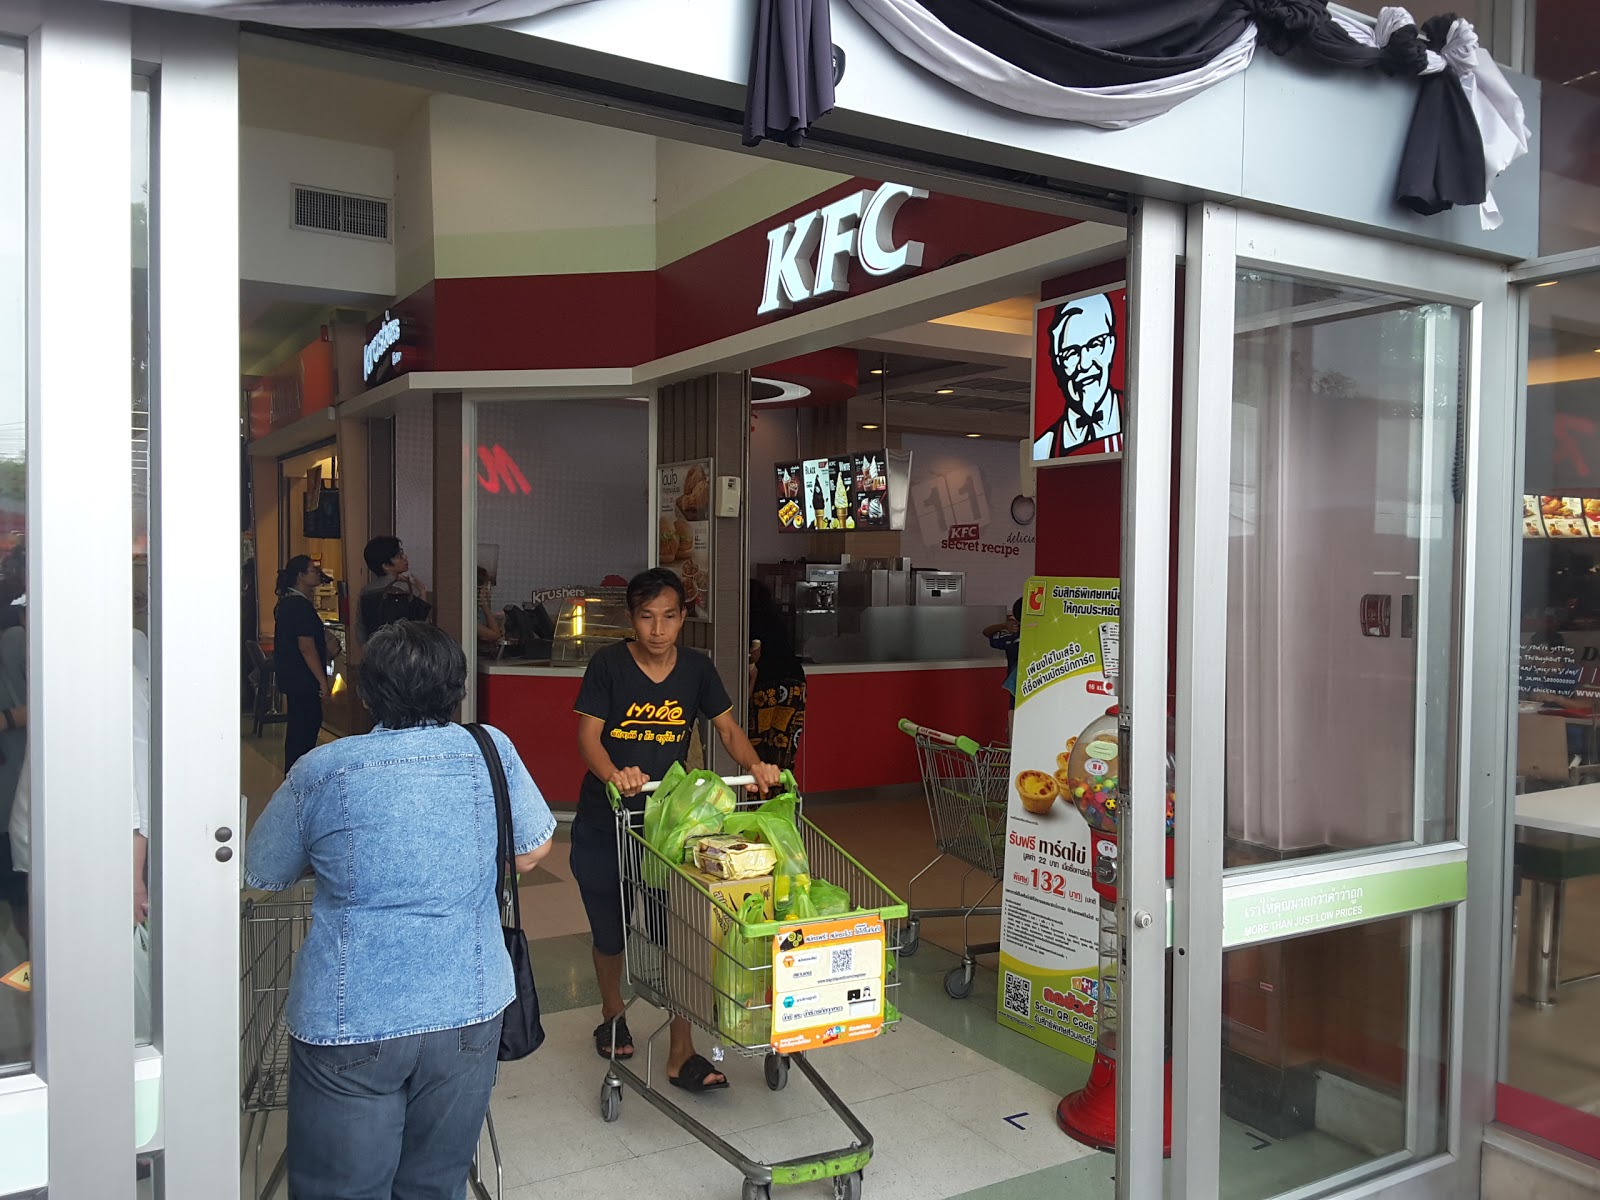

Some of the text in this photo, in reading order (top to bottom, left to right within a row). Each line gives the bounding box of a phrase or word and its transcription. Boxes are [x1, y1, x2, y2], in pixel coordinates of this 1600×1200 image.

[757, 181, 929, 315] KFC
[950, 526, 978, 539] KFC
[941, 539, 1020, 558] secret recipe
[624, 700, 685, 723] เขาค้อ
[1009, 830, 1036, 851] รับฟรี
[1023, 852, 1036, 862] มูลค่า
[1038, 856, 1047, 865] 22
[1049, 860, 1060, 869] บาท
[1013, 871, 1028, 885] พิเศษ
[1031, 868, 1065, 896] 132
[1069, 890, 1081, 900] บาท
[1244, 885, 1363, 918] เราให้คุณมากกว่าคำว่าถูก
[1244, 905, 1363, 937] MORE THAN JUST LOW PRICES
[1034, 1001, 1094, 1033] Scan QR Code
